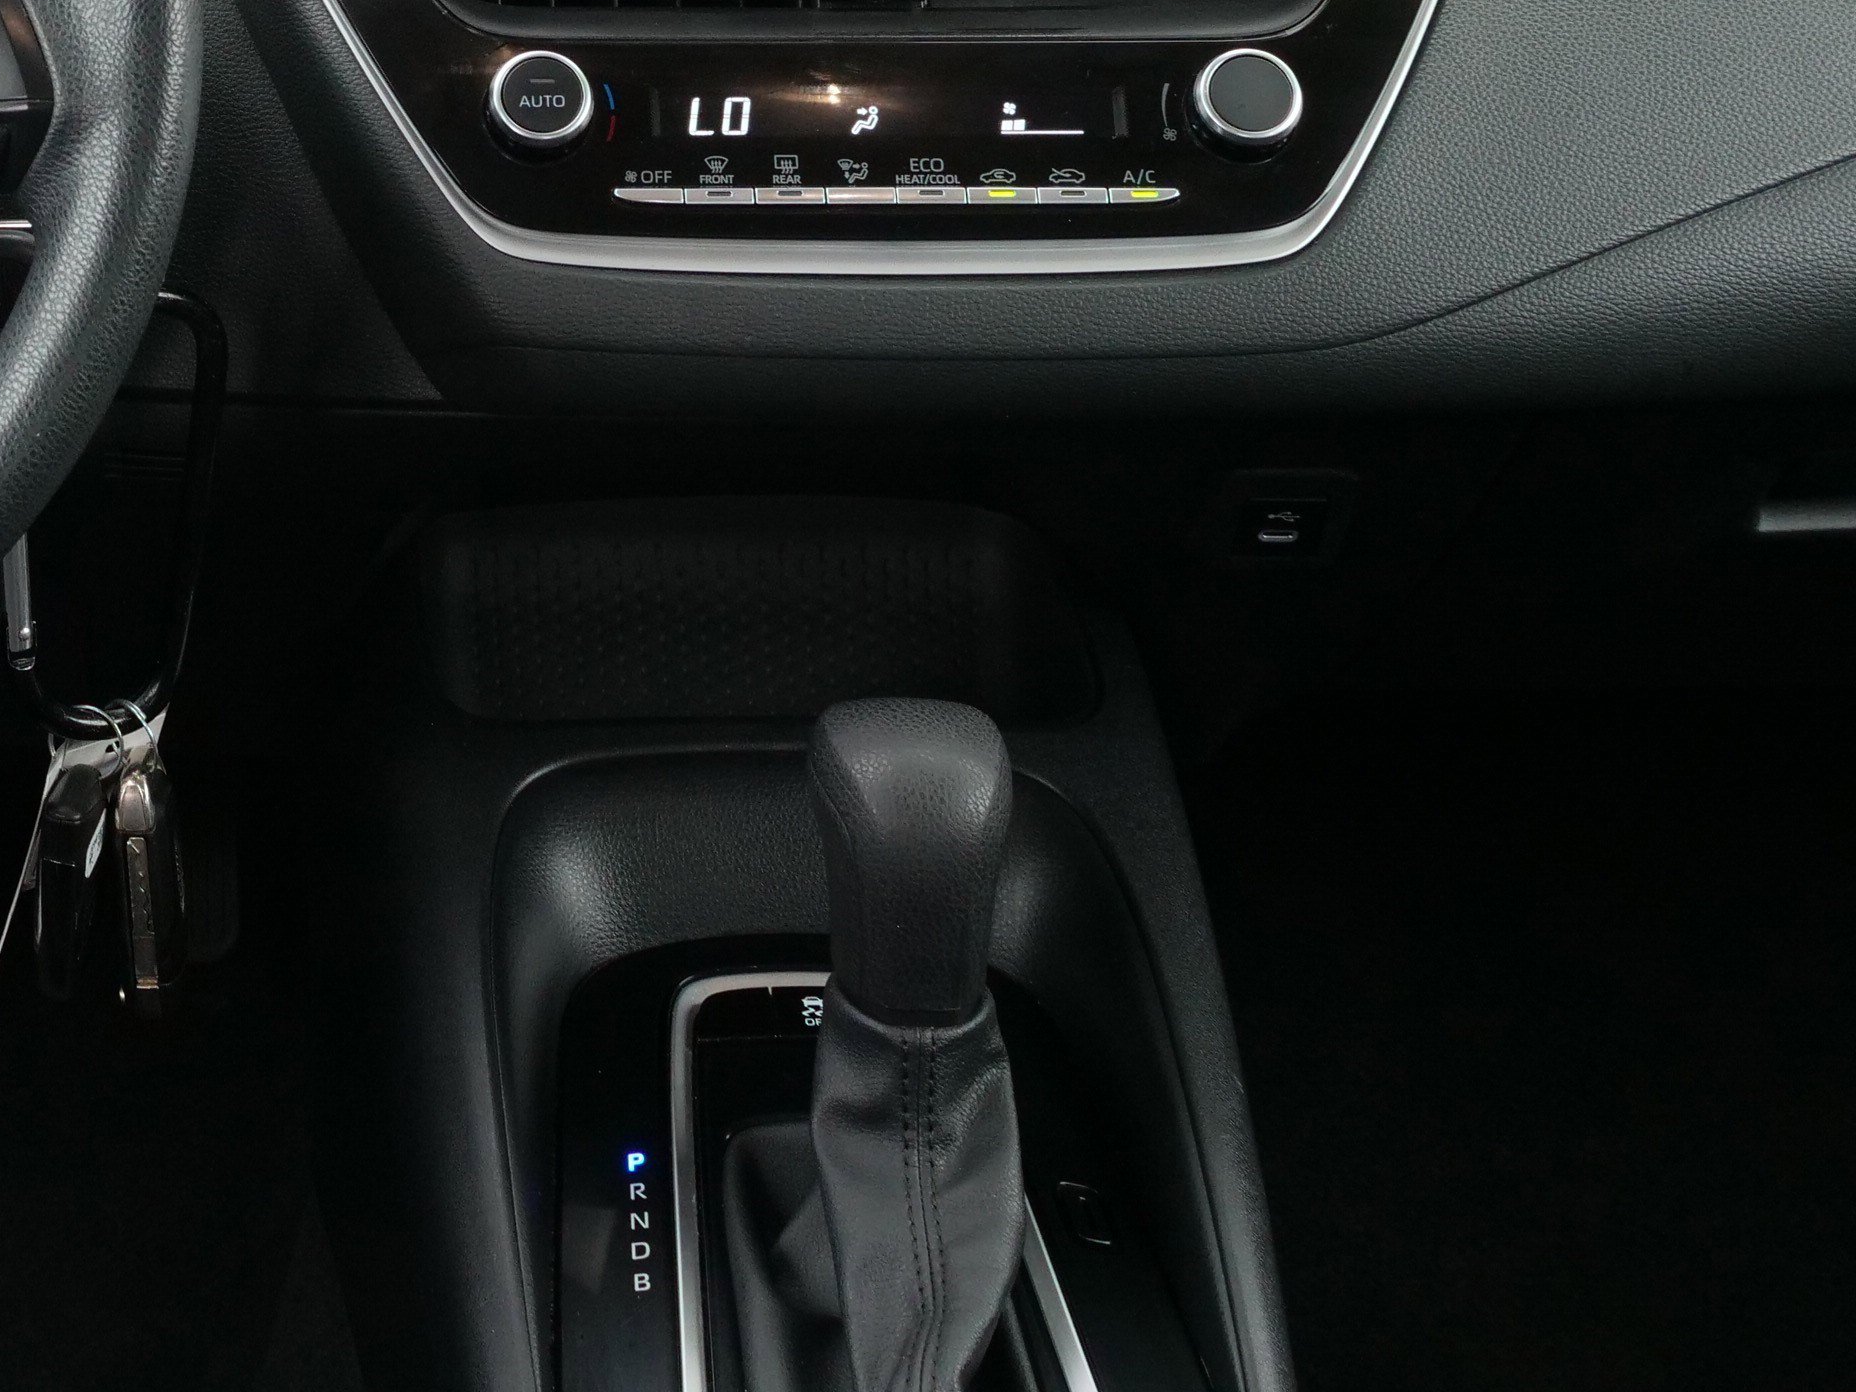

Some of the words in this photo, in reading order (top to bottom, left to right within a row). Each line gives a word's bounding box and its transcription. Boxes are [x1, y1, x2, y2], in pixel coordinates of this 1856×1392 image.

[519, 94, 566, 108] AUTO
[909, 157, 944, 172] ECO
[640, 170, 673, 184] OFF
[699, 174, 734, 184] FRONT
[772, 174, 802, 184] REAR
[895, 174, 961, 185] HEAT/COOL
[1123, 169, 1157, 184] A/C
[627, 1152, 645, 1172] P
[629, 1182, 648, 1201] R
[630, 1211, 650, 1230] N
[631, 1241, 651, 1260] D
[633, 1272, 651, 1292] B
